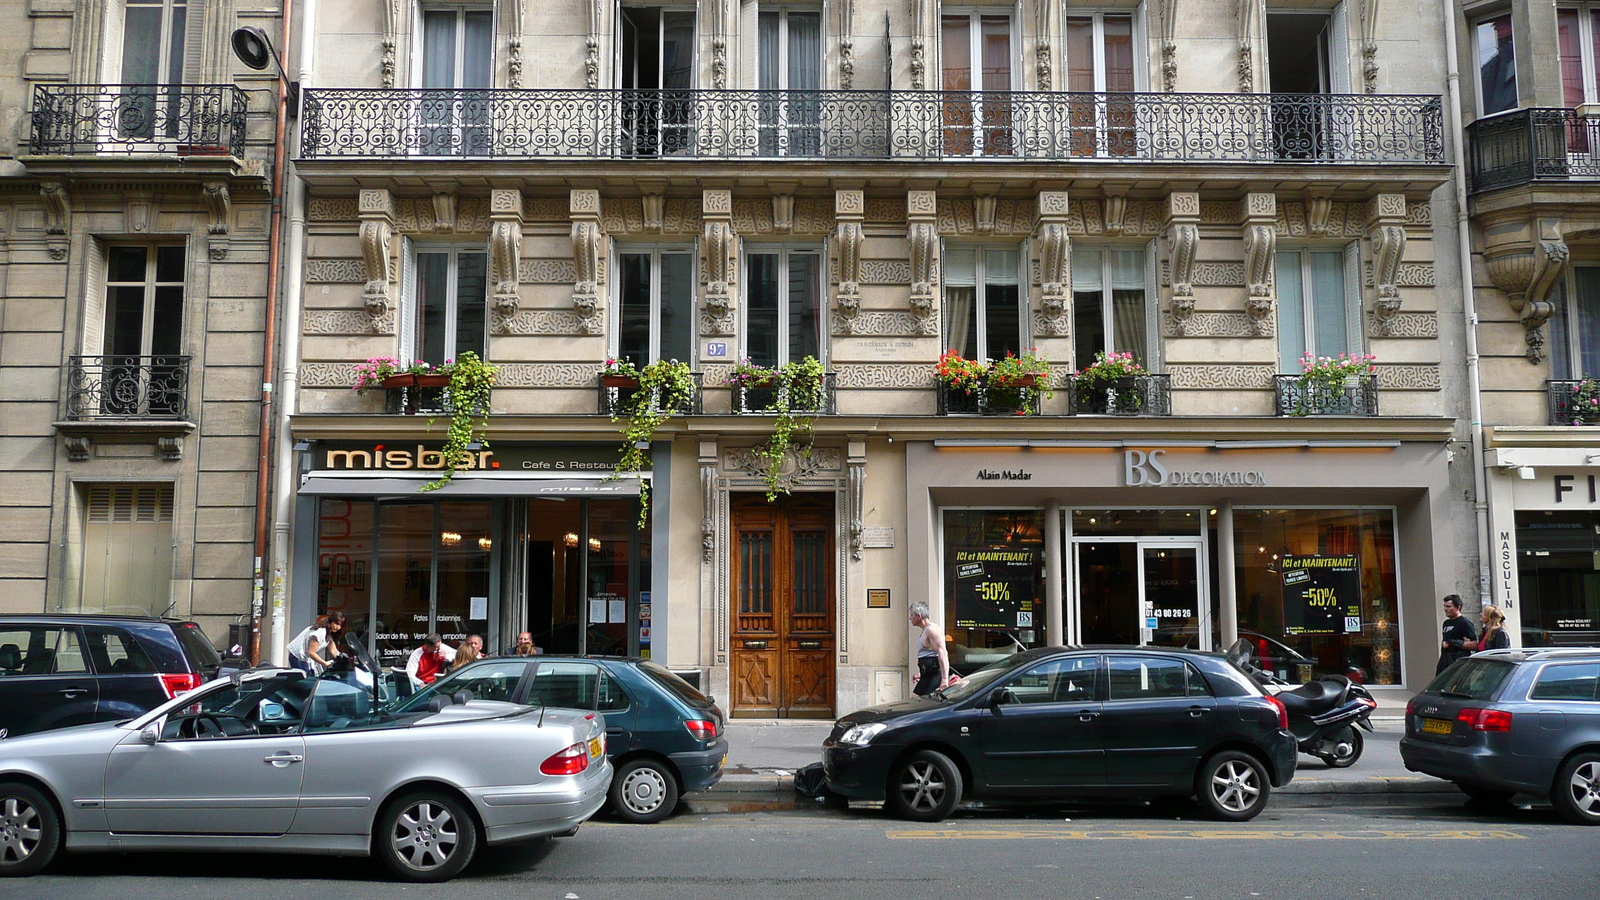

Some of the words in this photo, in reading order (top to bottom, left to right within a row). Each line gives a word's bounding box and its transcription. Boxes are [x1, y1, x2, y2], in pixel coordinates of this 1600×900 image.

[708, 343, 726, 355] 97
[555, 461, 566, 469] &
[1125, 450, 1168, 487] BS
[976, 469, 1001, 480] Alain
[1002, 469, 1033, 480] Madar
[956, 552, 968, 561] ICI
[968, 552, 976, 561] et
[977, 552, 1029, 562] MAINTENANT
[1282, 558, 1292, 567] ICI
[1293, 559, 1301, 567] et
[1302, 558, 1353, 567] MAINTENANT
[1500, 531, 1513, 609] MASCULIN
[1019, 612, 1031, 622] BS
[1145, 609, 1153, 617] 01
[1154, 609, 1162, 617] 43
[1173, 609, 1182, 617] 26
[1182, 609, 1191, 617] 26
[1347, 617, 1359, 627] BS
[442, 633, 467, 641] emporter
